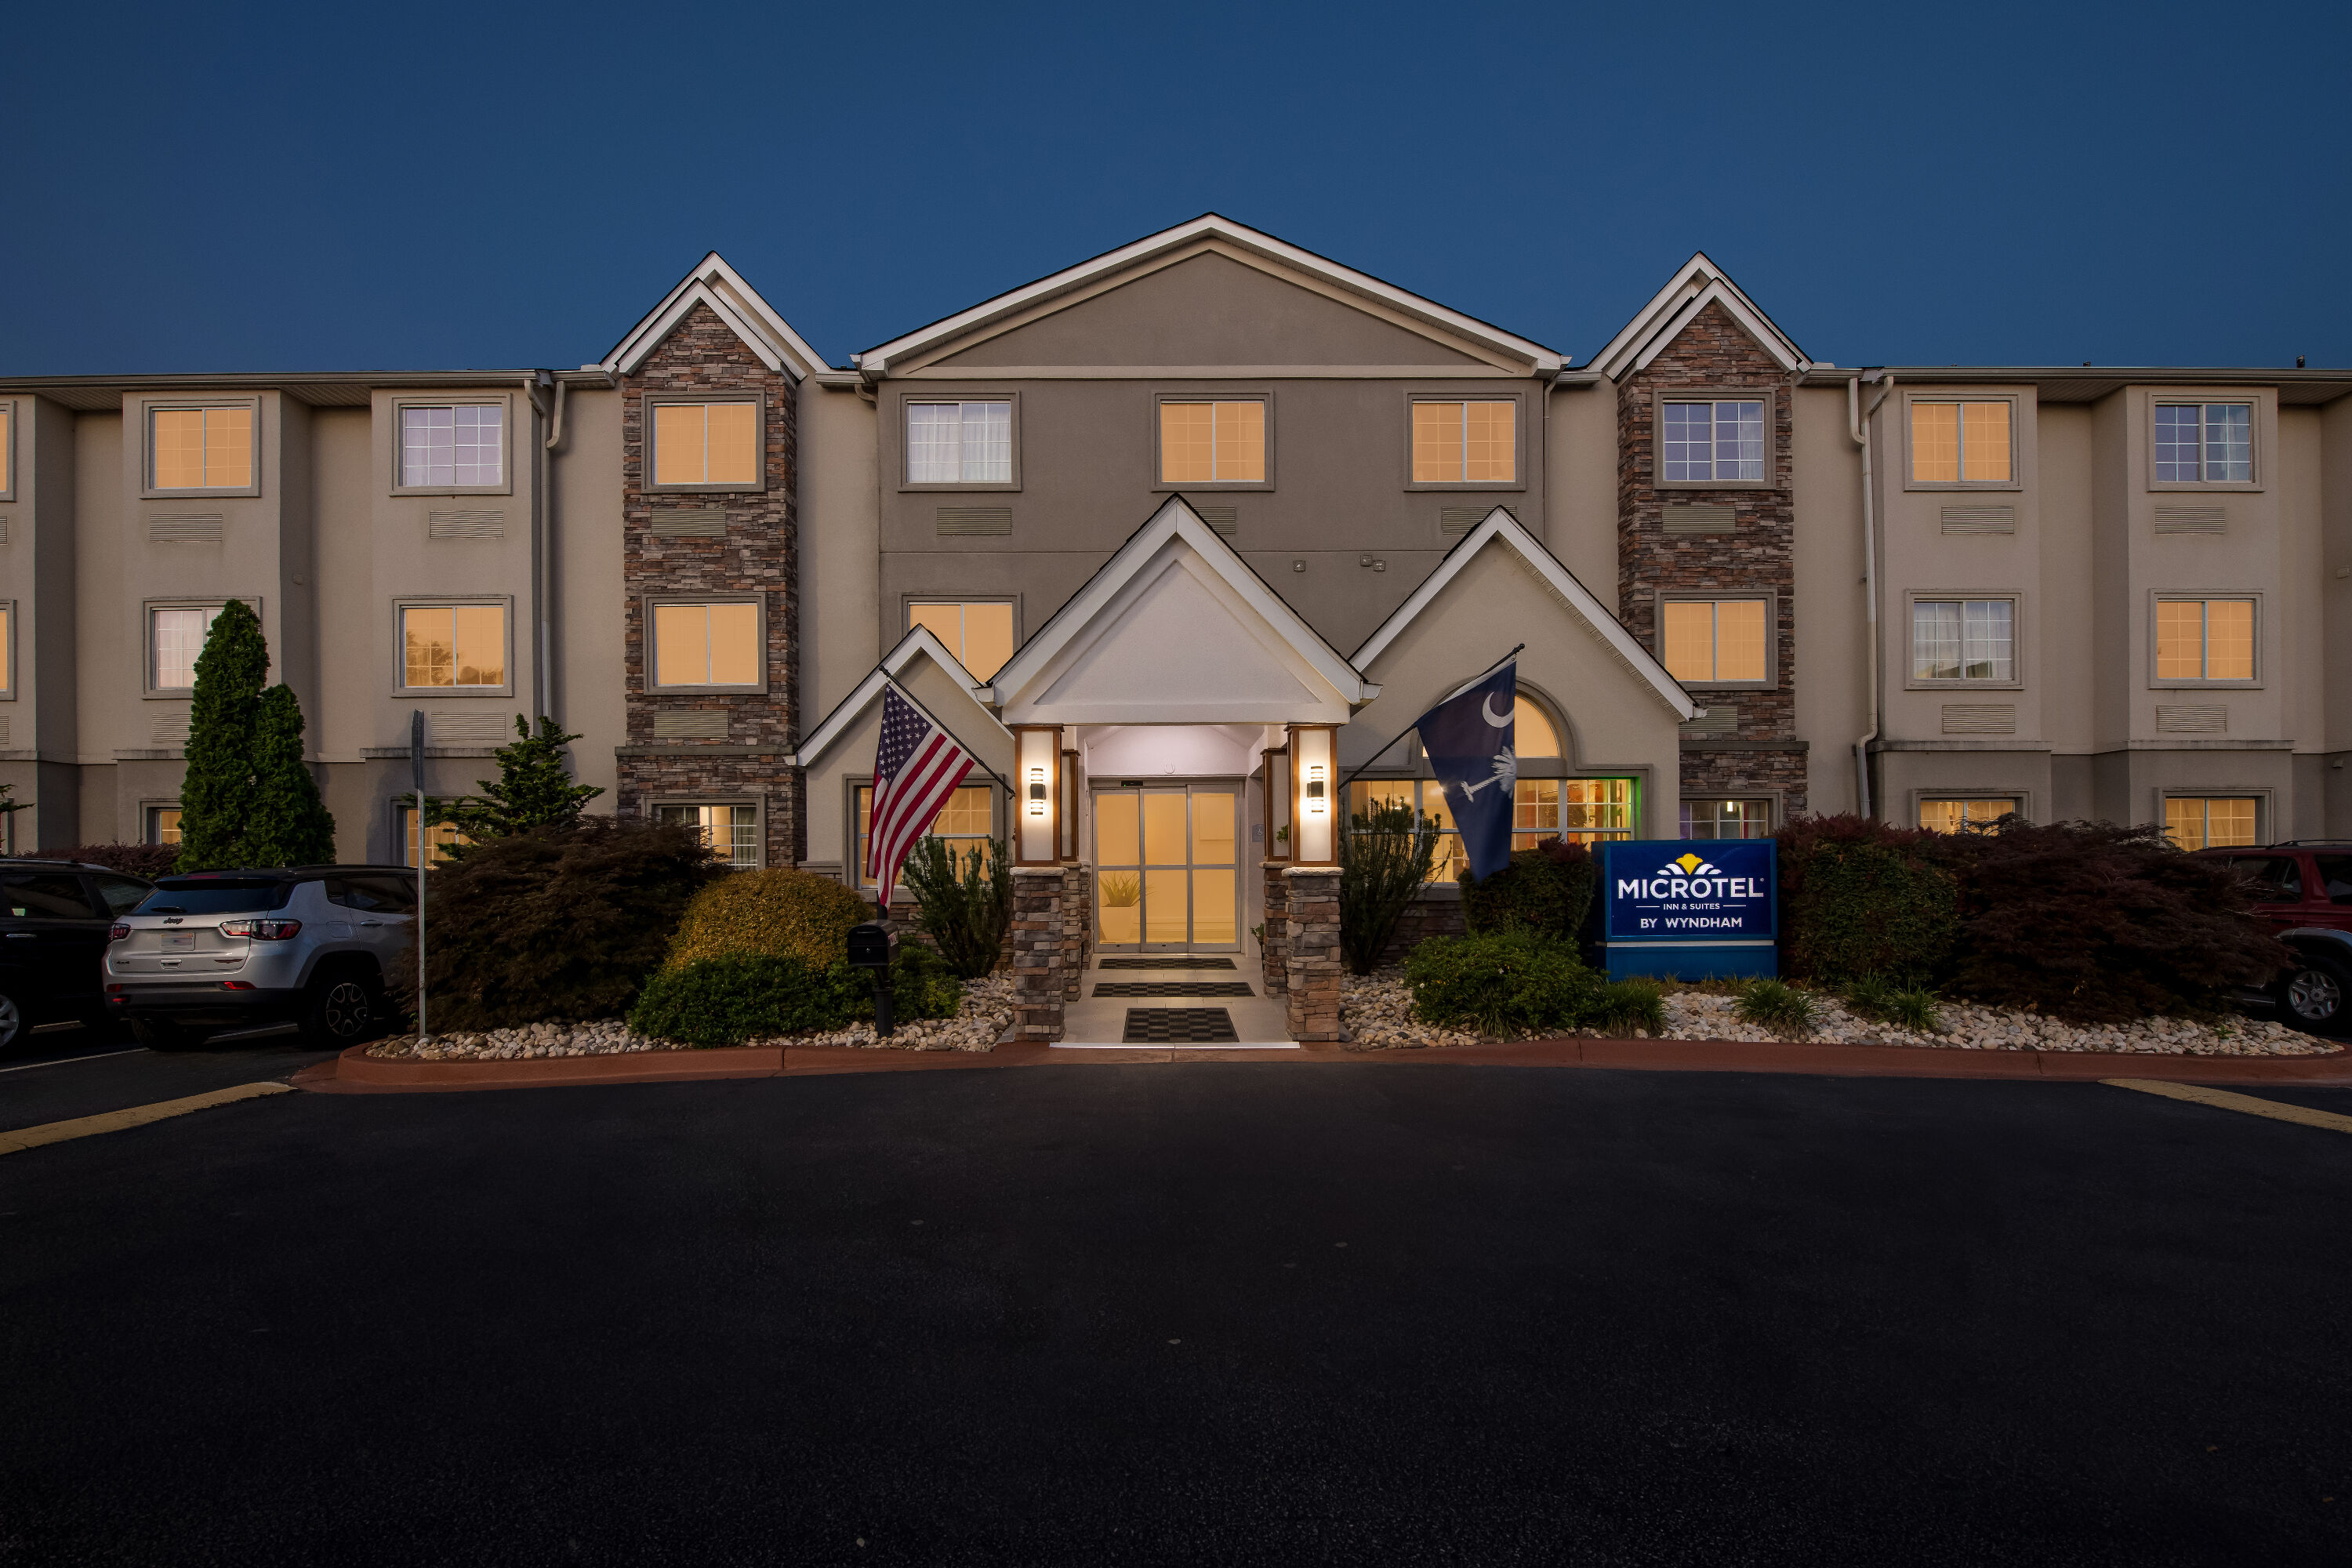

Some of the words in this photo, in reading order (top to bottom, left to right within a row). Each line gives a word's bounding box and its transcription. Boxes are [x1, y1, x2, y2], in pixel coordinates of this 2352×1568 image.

[163, 916, 184, 925] Jeep
[1640, 918, 1658, 928] BY
[1664, 916, 1742, 928] WYNDHAM
